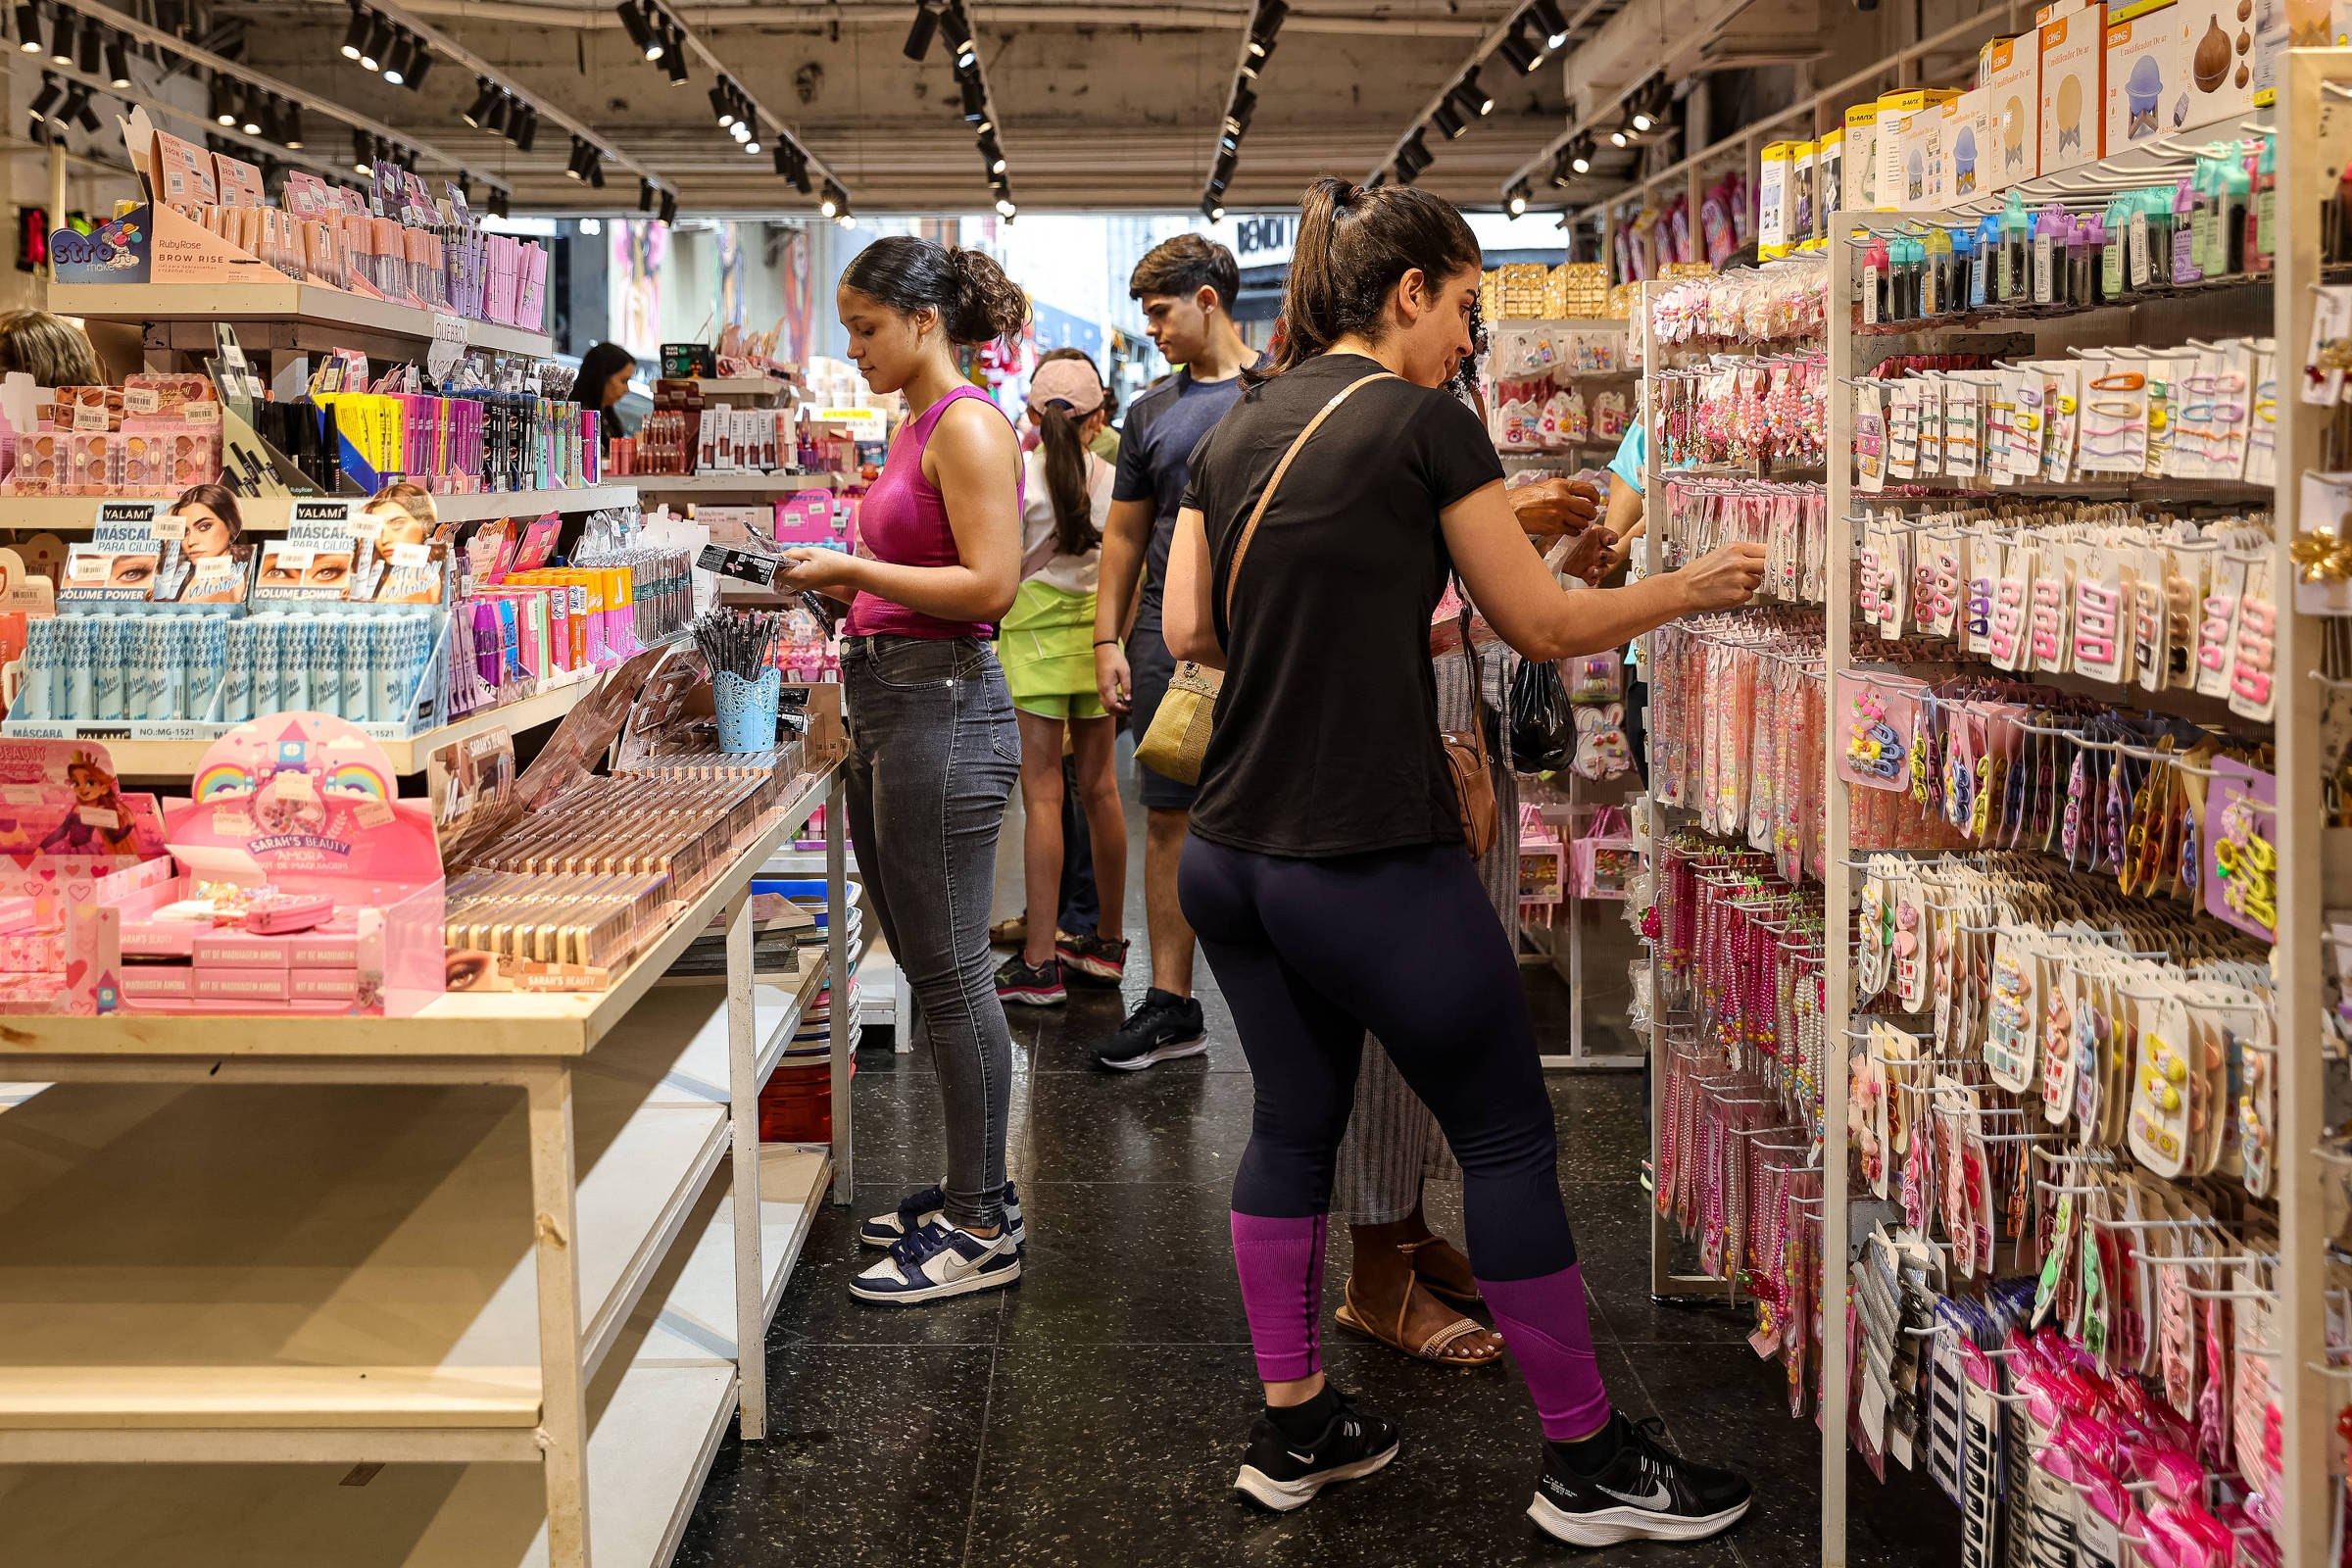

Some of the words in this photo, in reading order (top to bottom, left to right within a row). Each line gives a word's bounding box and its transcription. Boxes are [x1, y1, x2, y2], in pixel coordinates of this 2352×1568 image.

[159, 240, 202, 250] RubyRose
[159, 254, 193, 263] BROW
[198, 255, 224, 264] RISE
[98, 542, 125, 552] PARA
[60, 589, 103, 601] VOLUME
[106, 590, 144, 600] POWER
[255, 589, 301, 600] VOLUME
[302, 590, 340, 600] POWER
[13, 726, 64, 739] MÁSCARA
[470, 736, 492, 758] SARAH'S
[491, 728, 509, 747] BEAUTY
[251, 836, 302, 853] SARAH'S
[305, 836, 348, 853] BEAUTY
[527, 975, 564, 986] SARAH'S
[565, 976, 596, 986] BEAUTY
